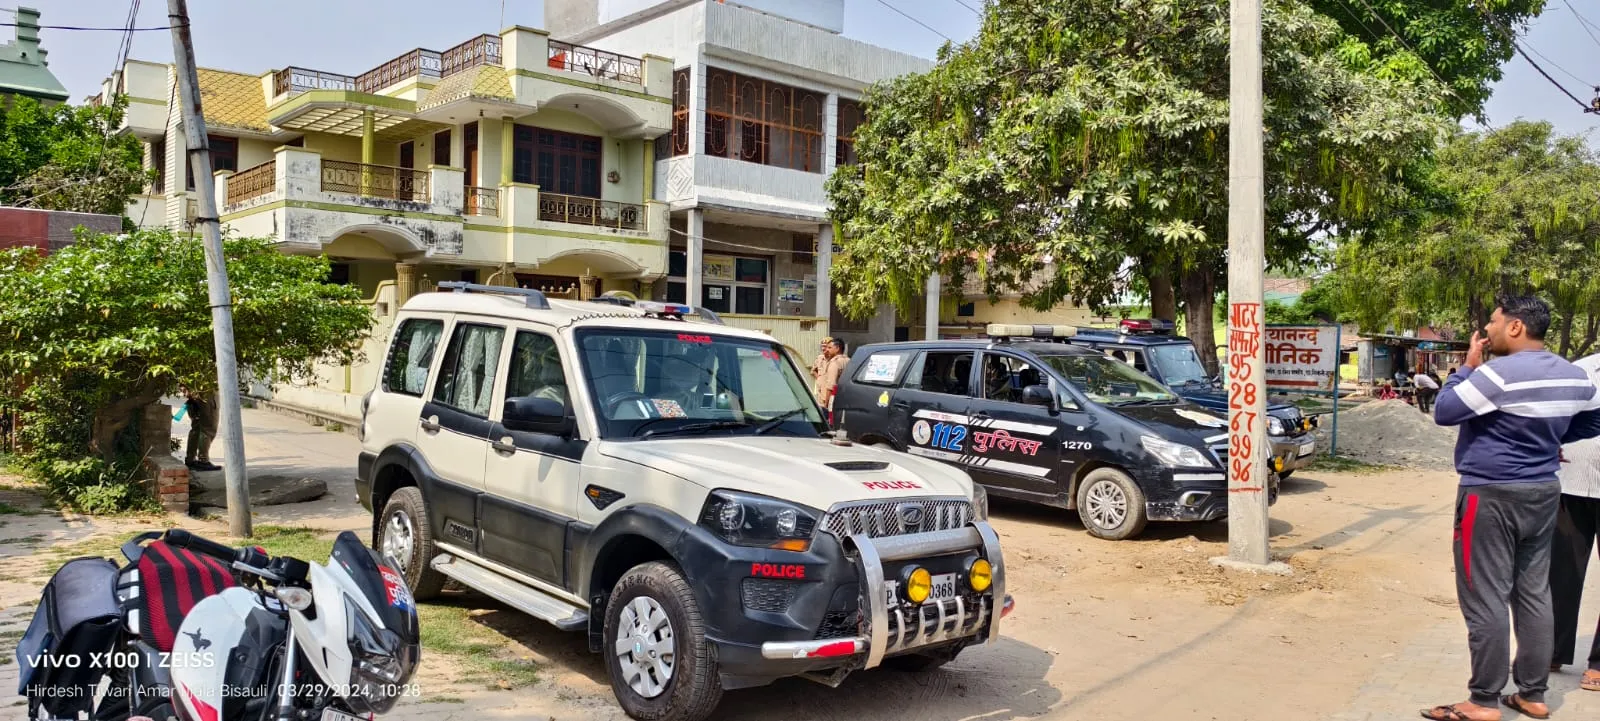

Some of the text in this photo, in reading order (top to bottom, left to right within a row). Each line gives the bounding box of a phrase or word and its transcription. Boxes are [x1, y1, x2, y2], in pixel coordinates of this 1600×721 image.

[1265, 328, 1319, 345] यानन्द
[1229, 353, 1251, 382] 95
[1229, 382, 1257, 409] 28
[1231, 411, 1257, 432] 67
[932, 422, 1043, 456] 112 पुलिस
[1062, 440, 1092, 450] 1270
[1229, 434, 1252, 460] 99
[1231, 459, 1252, 482] 96
[862, 480, 923, 490] POLICE
[751, 563, 806, 579] POLICE
